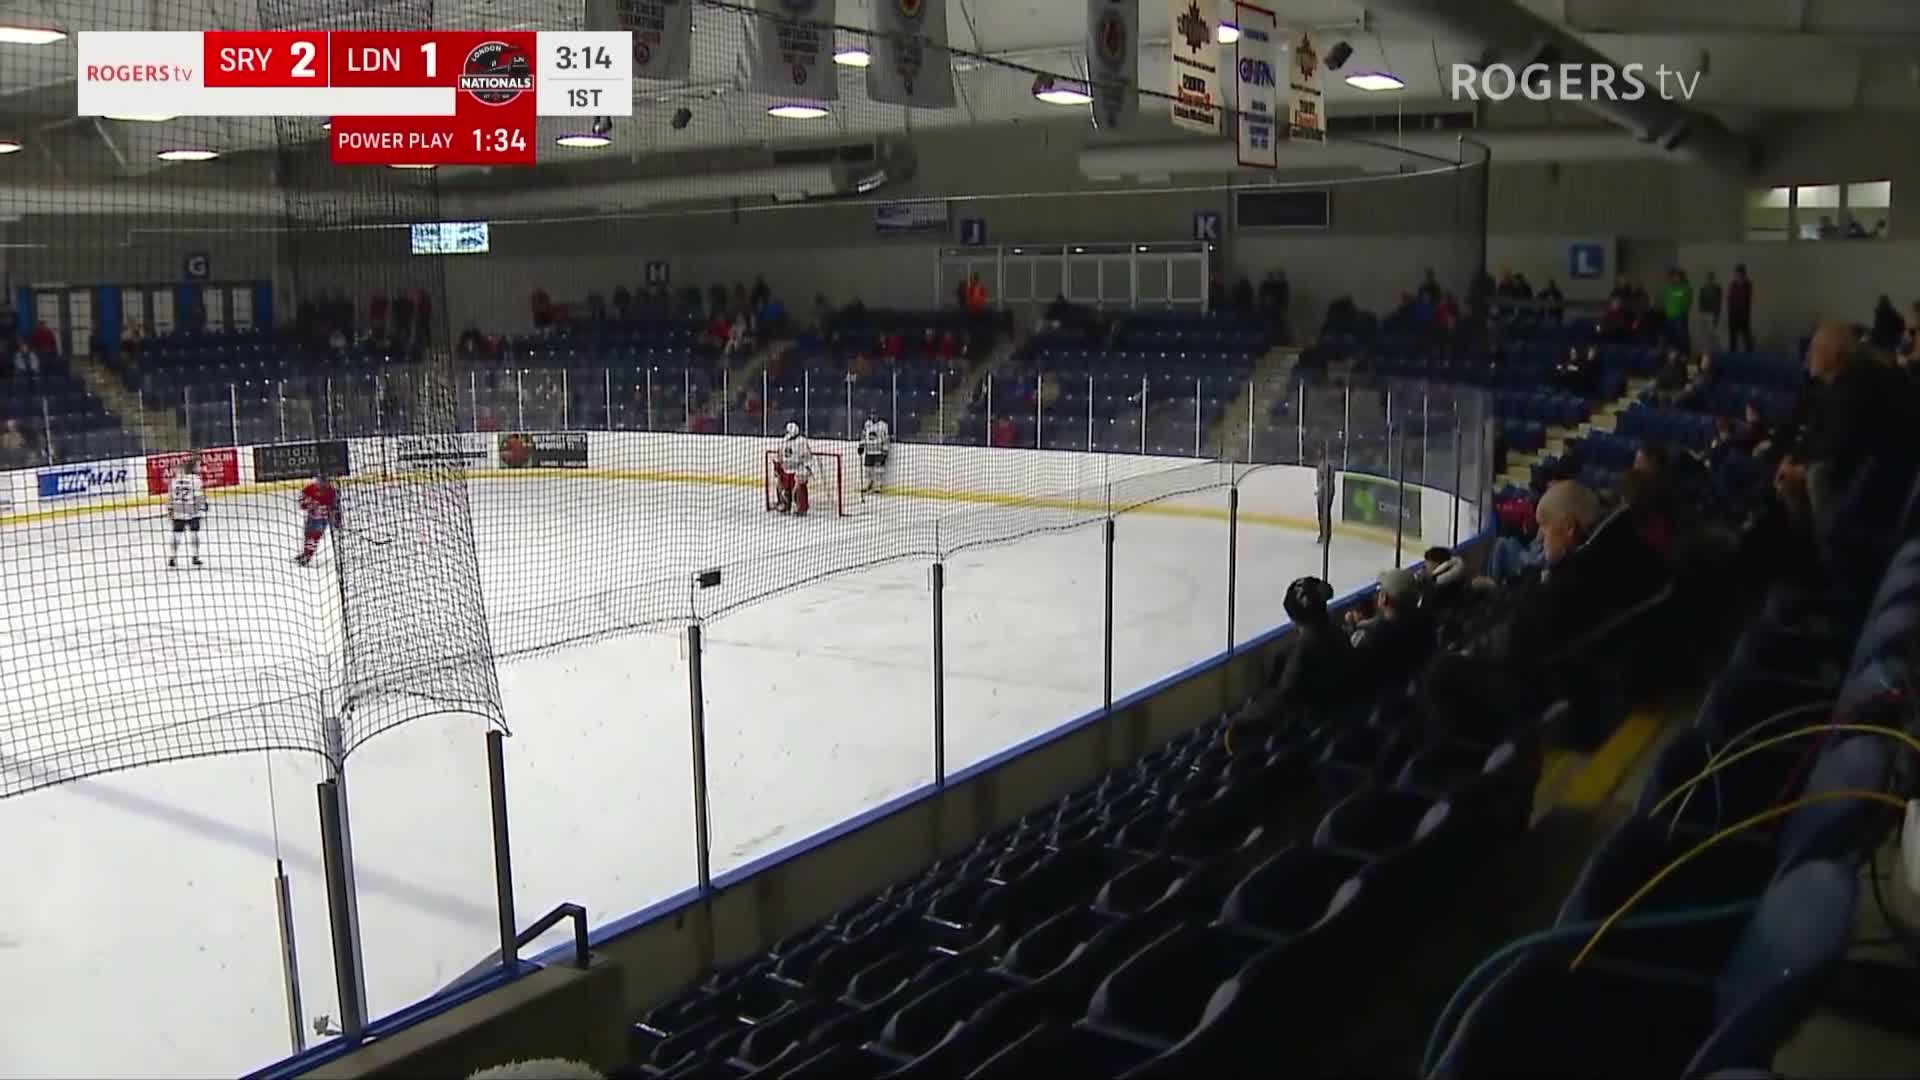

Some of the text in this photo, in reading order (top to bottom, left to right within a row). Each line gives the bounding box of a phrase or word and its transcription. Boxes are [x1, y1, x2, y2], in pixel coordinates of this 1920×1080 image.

[967, 223, 980, 244] J
[1197, 215, 1216, 239] K
[188, 256, 206, 276] G
[650, 263, 667, 281] H
[1578, 250, 1599, 273] L
[57, 469, 128, 491] WINMAR
